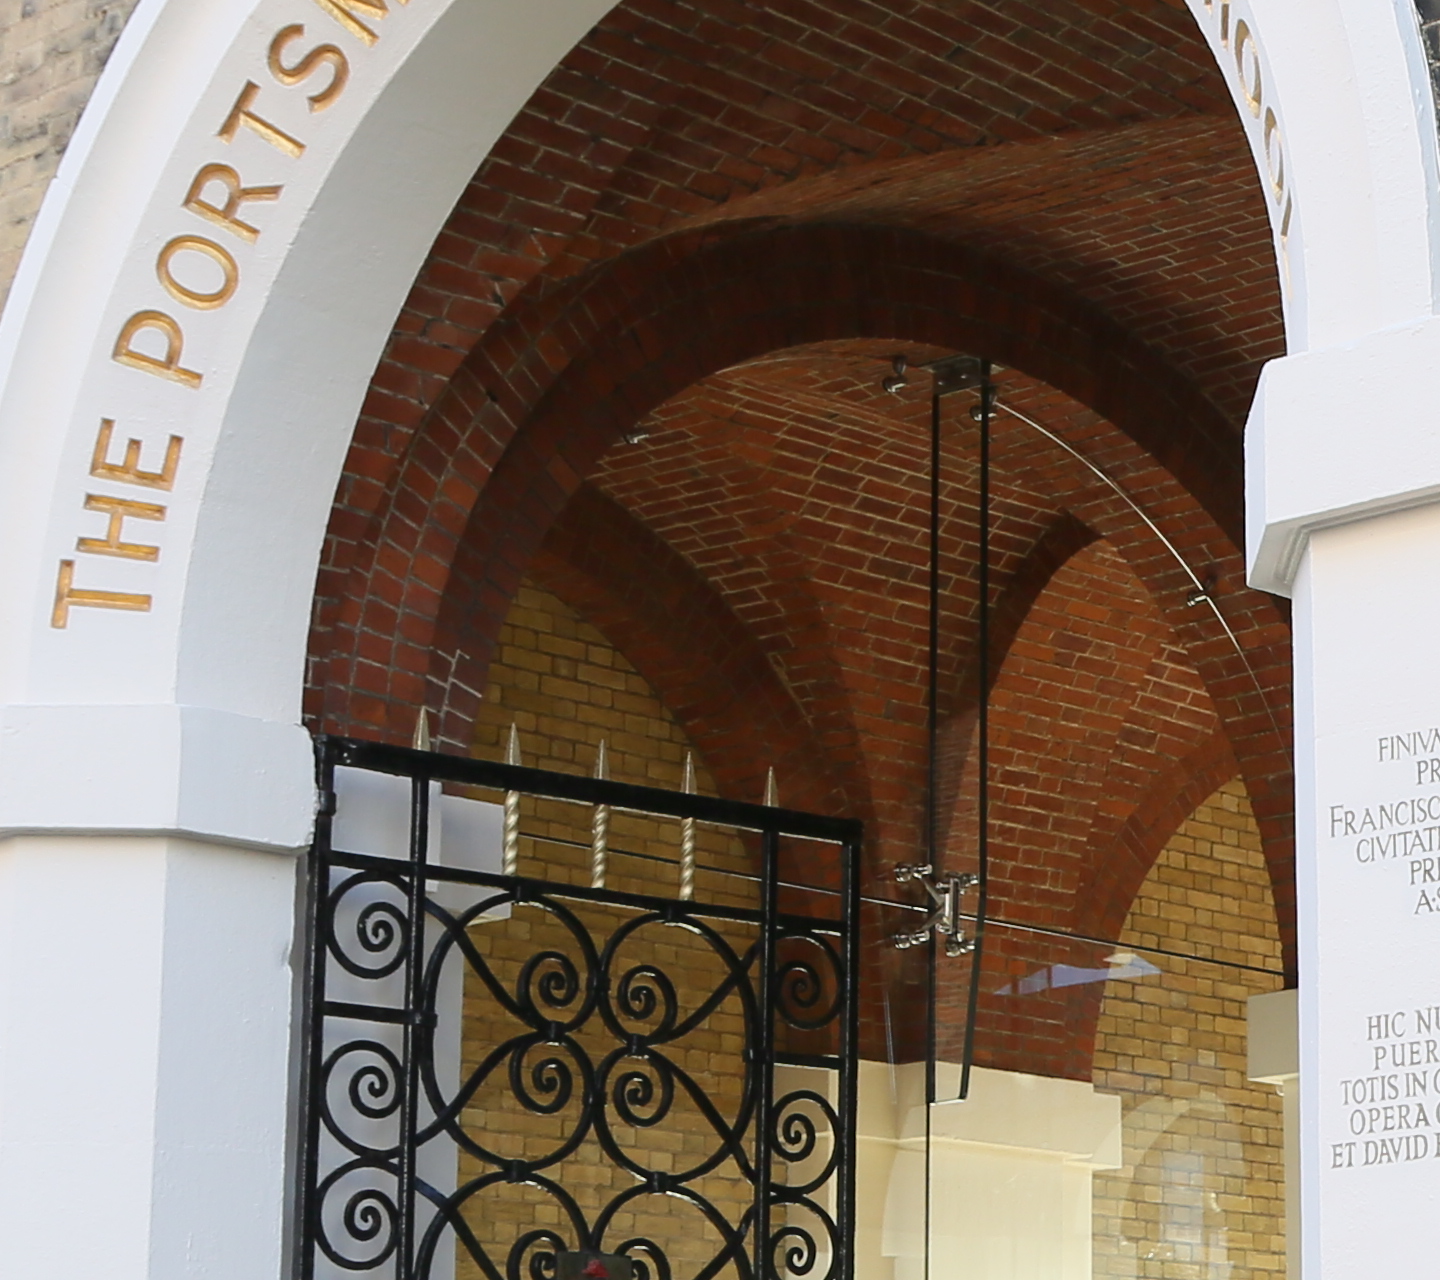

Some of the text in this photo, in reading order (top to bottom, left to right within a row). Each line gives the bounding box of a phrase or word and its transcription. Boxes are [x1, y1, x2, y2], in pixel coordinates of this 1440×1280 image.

[51, 417, 185, 630] THE
[1367, 1012, 1407, 1041] HIC
[1341, 1076, 1399, 1106] TOTIS
[1405, 1071, 1427, 1098] IN
[1350, 1104, 1432, 1136] OPERA
[1331, 1142, 1356, 1169] ET
[1363, 1134, 1428, 1167] DAVID
